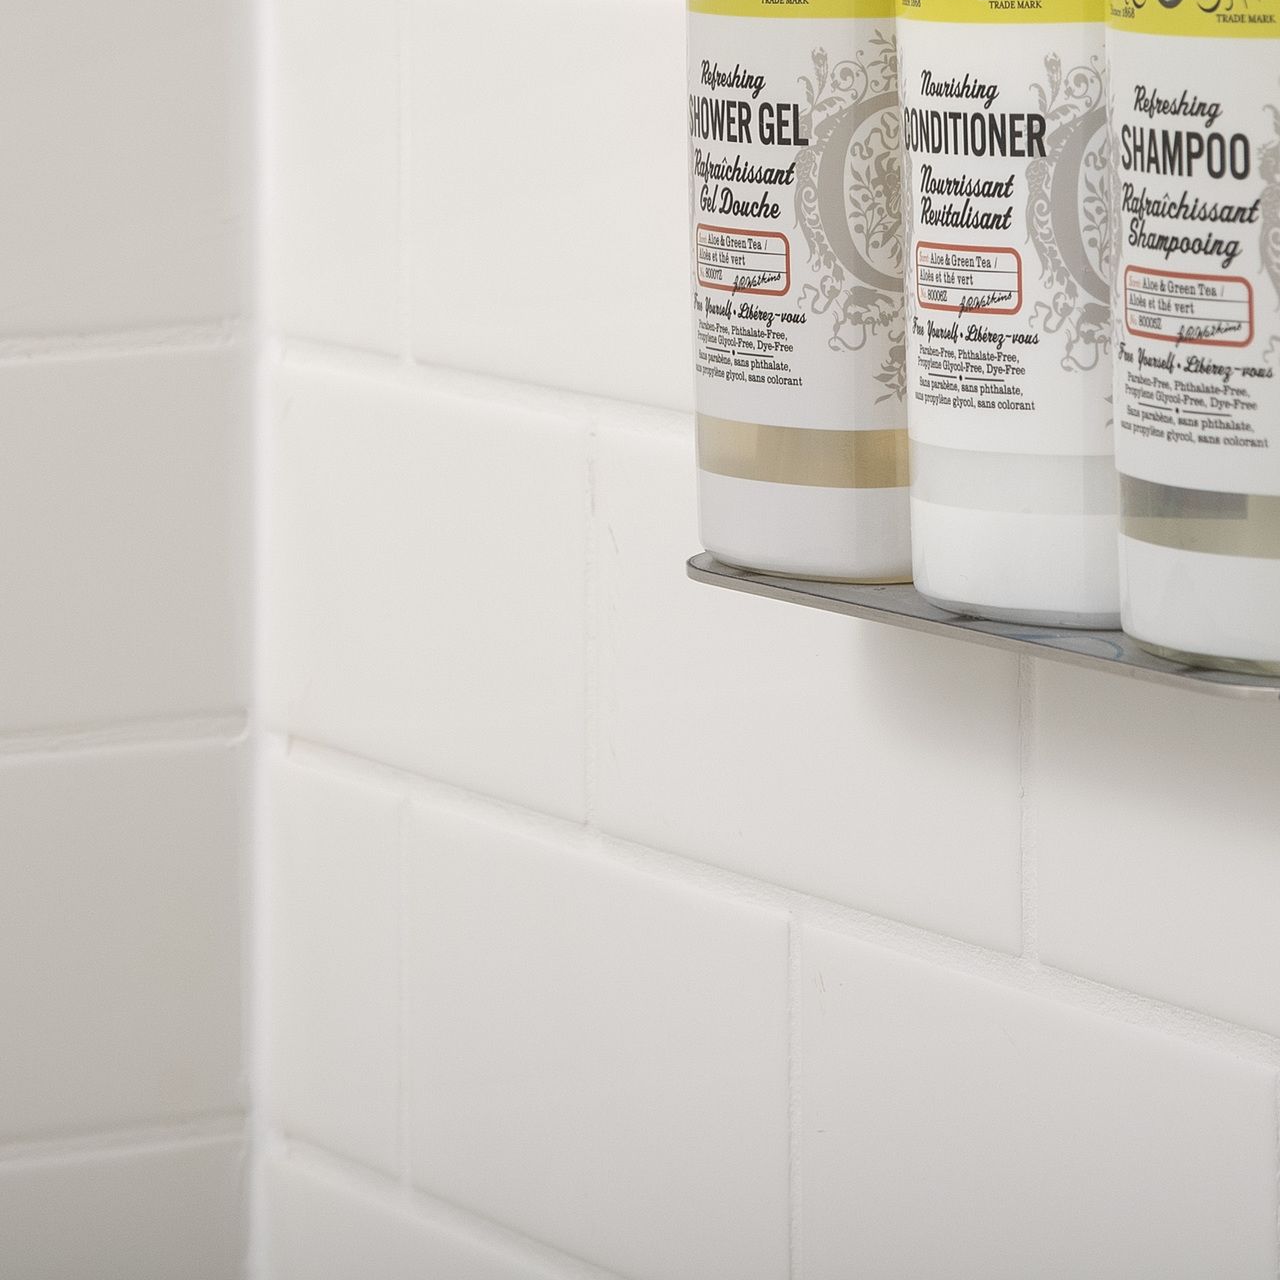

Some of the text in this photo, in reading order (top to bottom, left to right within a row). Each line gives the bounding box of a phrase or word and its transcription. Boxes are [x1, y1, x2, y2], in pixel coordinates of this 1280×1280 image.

[989, 0, 1042, 9] TRADE MARK
[1216, 14, 1276, 24] TRADE MARK
[701, 59, 766, 99] Refreshing
[921, 69, 999, 109] Nourishing
[1133, 85, 1223, 128] Refreshing
[689, 94, 809, 146] SHOWER GEL
[904, 106, 1047, 157] CONDITIONER
[1121, 124, 1251, 180] SHAMPOO
[694, 148, 796, 186] Rafraîchissant
[921, 163, 1015, 199] Nourrissant
[700, 184, 781, 219] Gel Douche
[1122, 182, 1261, 223] Rafraîchissant
[921, 195, 1013, 230] Revitalisant
[708, 233, 720, 245] Aloe
[721, 234, 726, 247] &
[726, 236, 746, 249] Green
[747, 238, 762, 250] Tea
[1128, 217, 1243, 269] Shampooing
[712, 251, 718, 262] et
[719, 251, 729, 264] thé
[731, 254, 746, 266] vert
[930, 253, 943, 265] Aloe
[945, 254, 950, 266] &
[951, 254, 975, 267] Green
[976, 256, 992, 268] Tea
[919, 268, 974, 286] Aloès et thé vert
[1142, 278, 1158, 291] Aloe
[1159, 279, 1166, 293] &
[1167, 280, 1196, 295] Green
[1198, 283, 1217, 297] Tea
[705, 296, 732, 320] Yourself
[737, 302, 807, 328] Libérez-vous
[1129, 293, 1195, 314] Aloès et thé vert
[731, 325, 788, 341] Phthalate-Free,
[927, 320, 959, 344] Yourself
[964, 324, 1040, 350] Libérez-vous
[757, 339, 794, 353] Dye-Free
[734, 358, 750, 368] sans
[750, 358, 792, 373] phthalate,
[958, 349, 1020, 364] Phthalate-Free,
[1118, 342, 1274, 383] Free Yourself Libérez-vous
[942, 360, 985, 374] Glycol-Free,
[986, 363, 1026, 376] Dye-Free
[726, 370, 748, 383] glycol,
[748, 374, 766, 385] sans
[766, 375, 803, 387] colorant
[961, 384, 978, 393] sans
[980, 384, 1024, 397] phthalate,
[1173, 379, 1251, 398] Phthalate-Free,
[952, 396, 976, 409] glycol,
[977, 400, 996, 410] sans
[997, 400, 1036, 411] colorant
[1210, 396, 1258, 411] Dye-Free
[1178, 417, 1199, 428] sans
[1201, 417, 1255, 433] phthalate,
[1166, 429, 1196, 444] glycol,
[1197, 434, 1220, 445] sans
[1223, 434, 1269, 449] colorant
